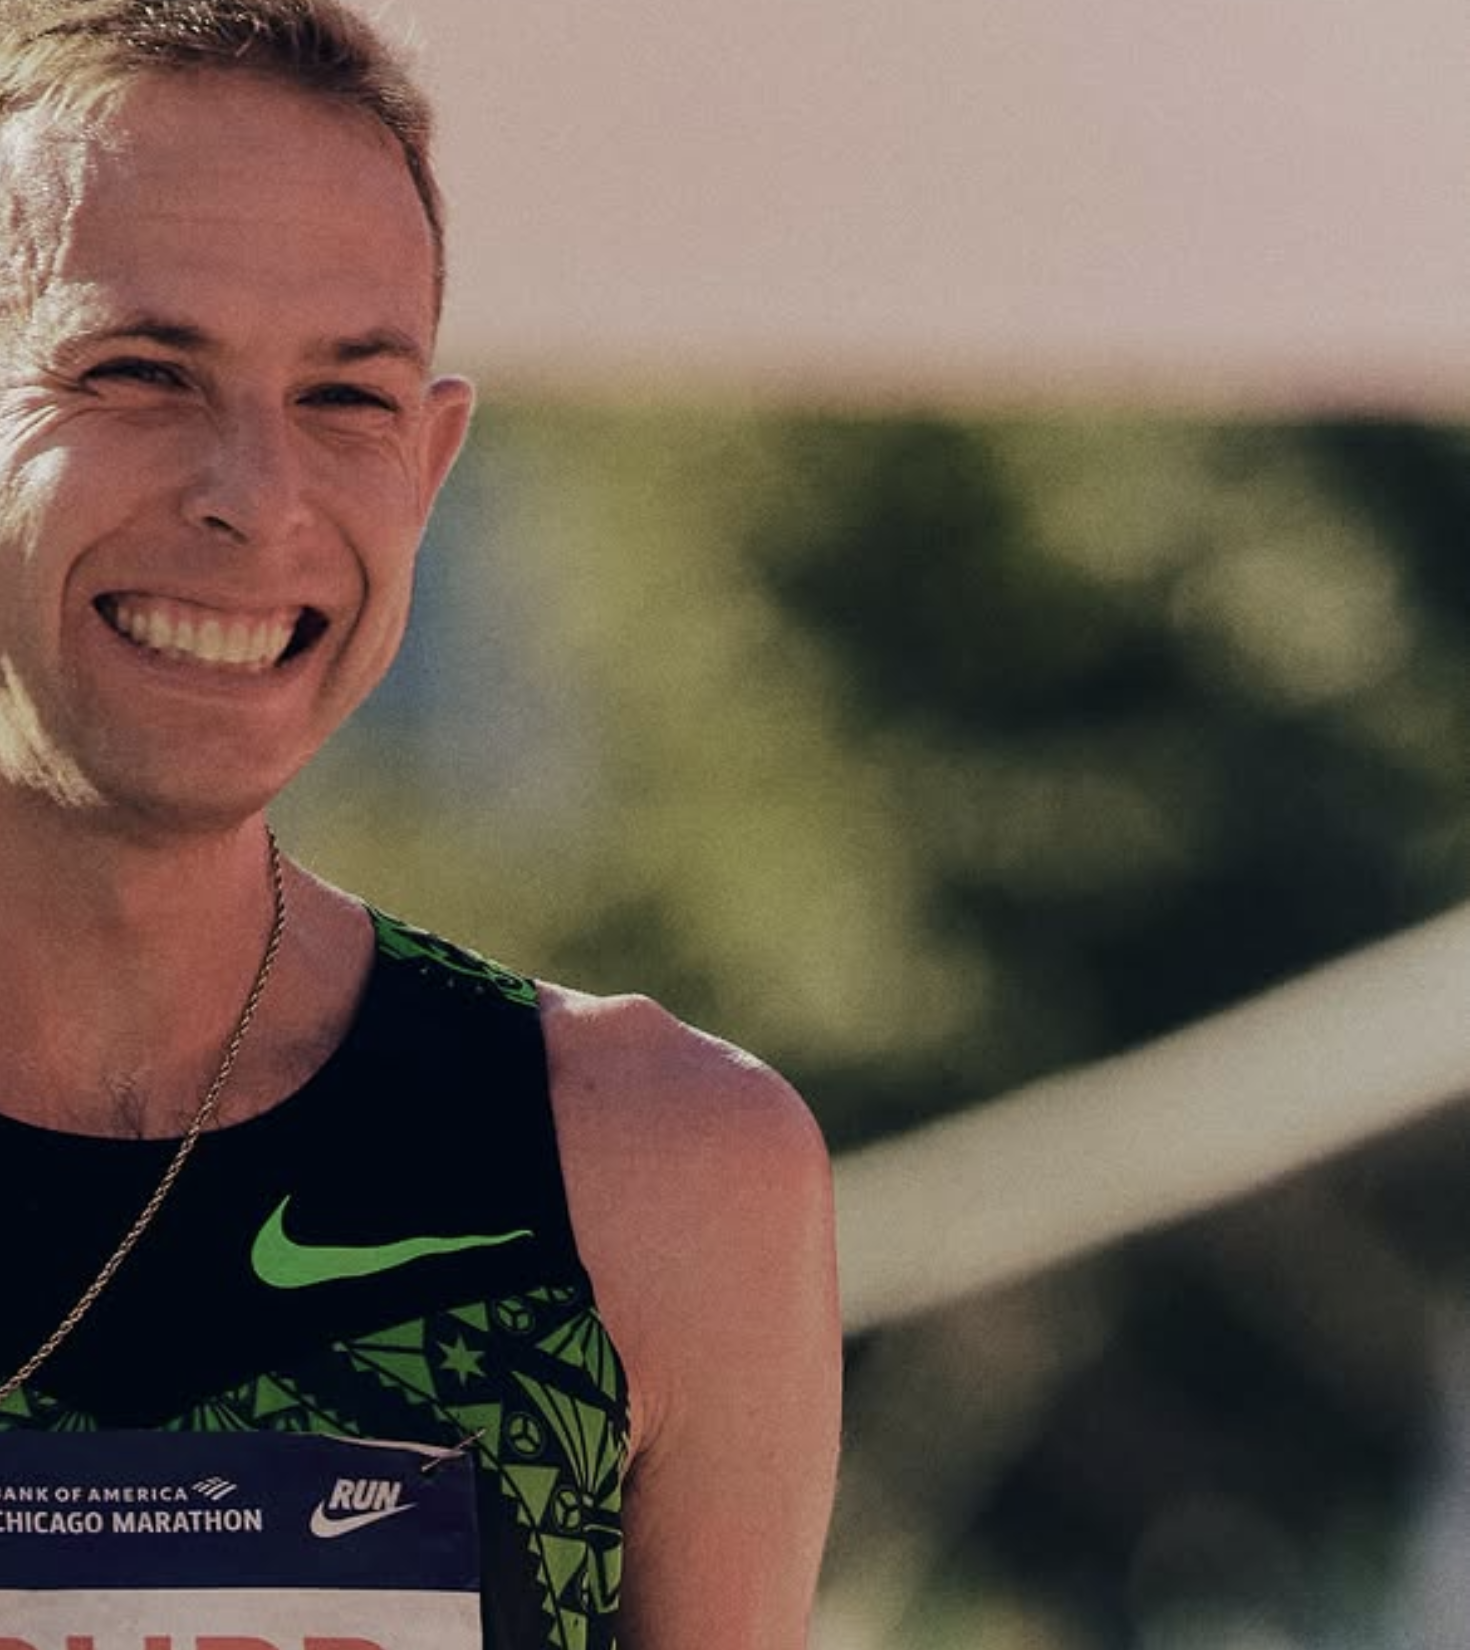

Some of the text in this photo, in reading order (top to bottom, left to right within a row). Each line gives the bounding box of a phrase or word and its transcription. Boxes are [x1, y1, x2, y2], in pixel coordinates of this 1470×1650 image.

[54, 1486, 82, 1503] OF
[87, 1486, 189, 1503] AMERICA
[328, 1478, 402, 1511] RUN
[112, 1508, 263, 1533] MARATHON
